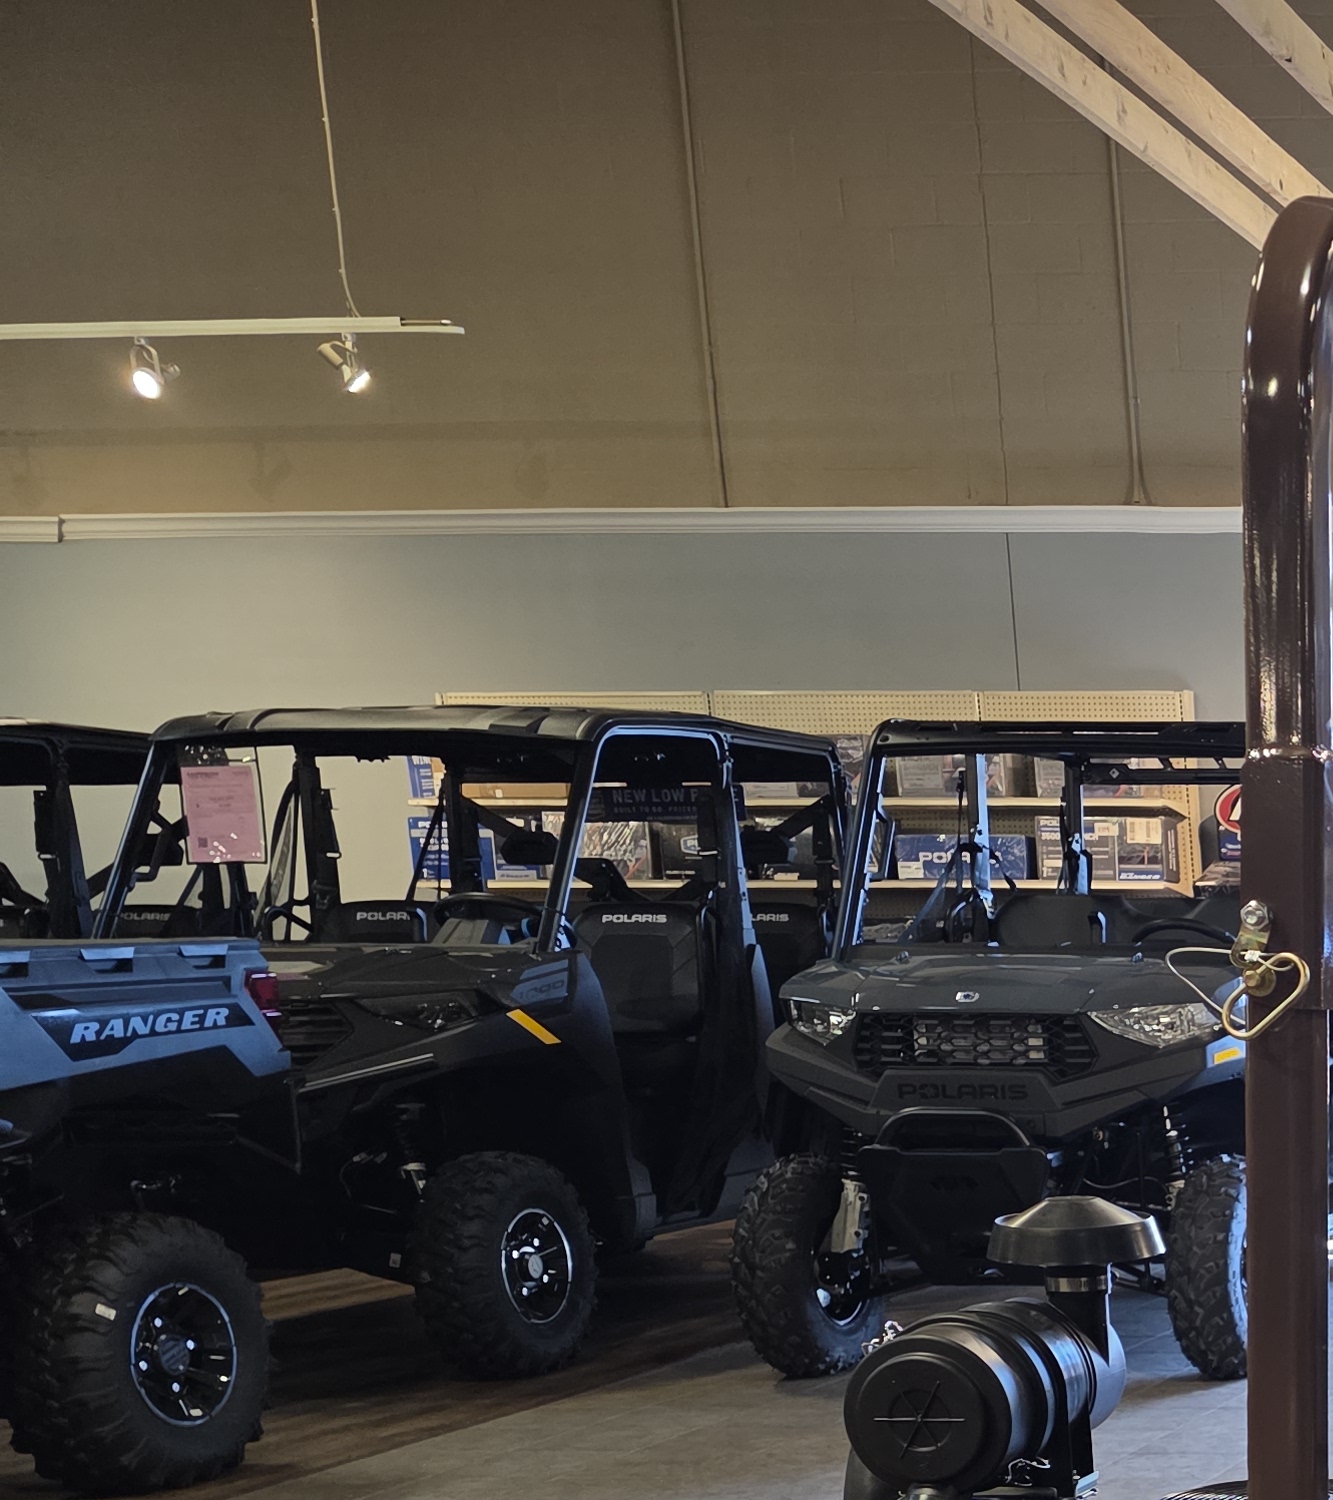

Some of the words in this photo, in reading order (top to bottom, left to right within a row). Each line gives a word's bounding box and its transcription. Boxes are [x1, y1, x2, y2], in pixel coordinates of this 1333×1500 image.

[612, 789, 648, 804] NEW
[651, 788, 689, 802] LOW
[120, 912, 172, 922] OLARIS
[356, 911, 411, 922] POLAR
[602, 914, 667, 923] POLARIS
[751, 912, 789, 922] LARIS
[70, 1007, 230, 1044] RANGER
[897, 1083, 1029, 1100] POLARIS
